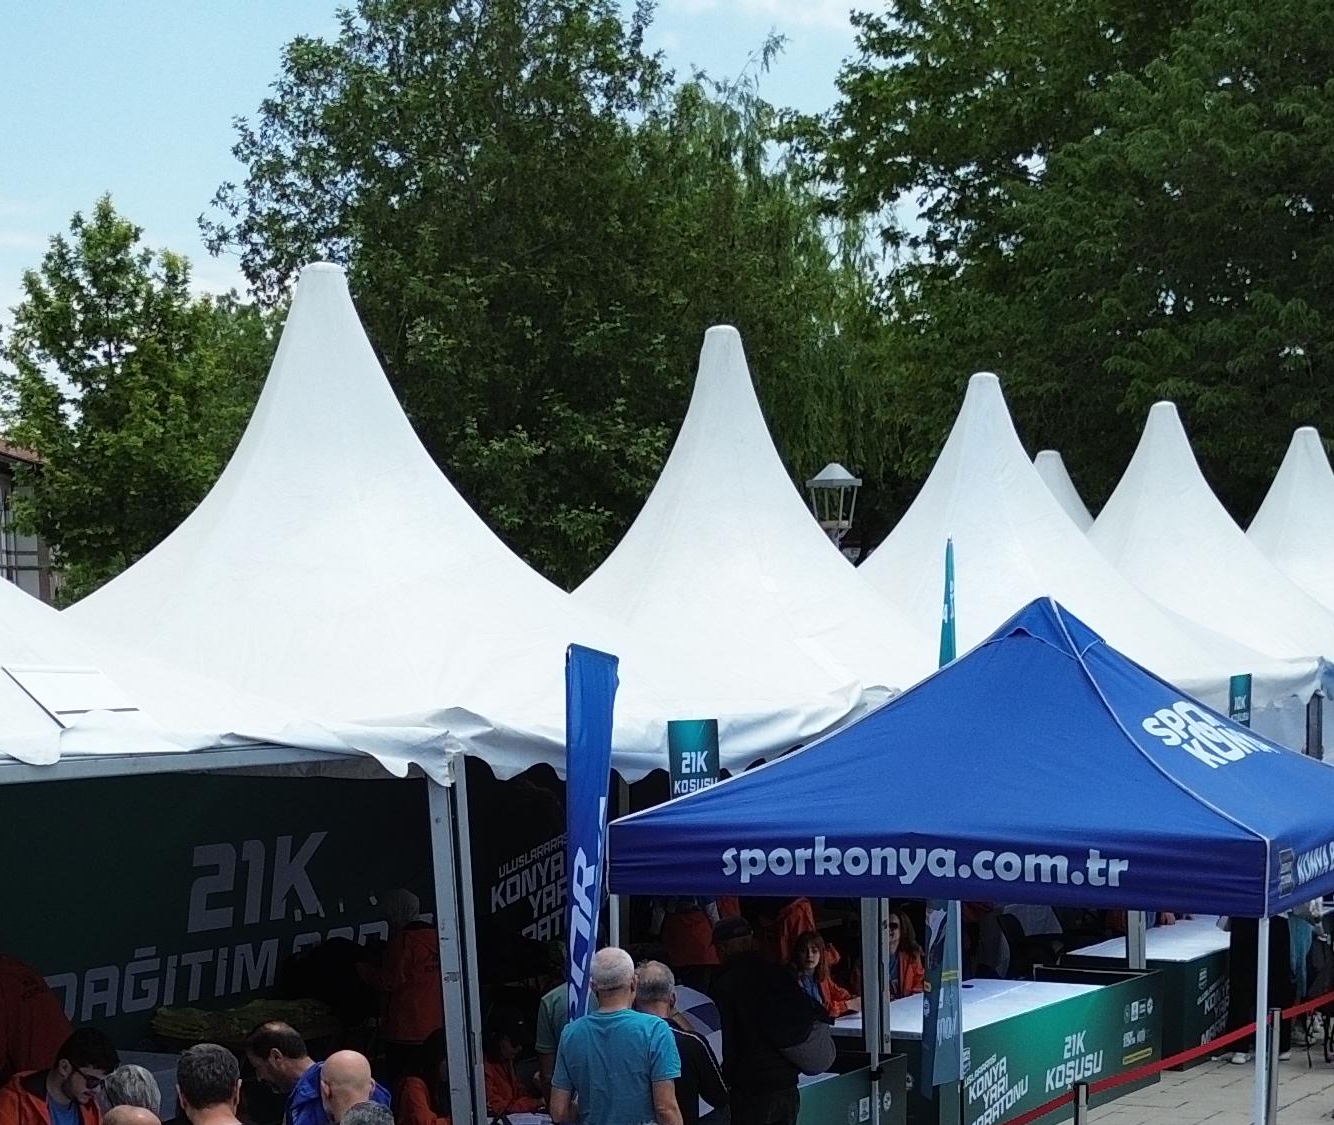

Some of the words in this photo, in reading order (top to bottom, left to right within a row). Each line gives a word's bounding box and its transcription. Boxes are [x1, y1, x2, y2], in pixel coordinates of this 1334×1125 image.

[681, 751, 707, 774] 21K
[187, 831, 329, 934] 21K
[490, 850, 564, 914] KONYA
[721, 835, 1129, 887] sporkonya.com.tr
[1296, 850, 1329, 885] KONYA
[1063, 1030, 1087, 1060] 21K
[968, 1056, 1007, 1105] KONYA
[983, 1074, 1008, 1109] YARI
[1045, 1049, 1104, 1093] KOŞUSU
